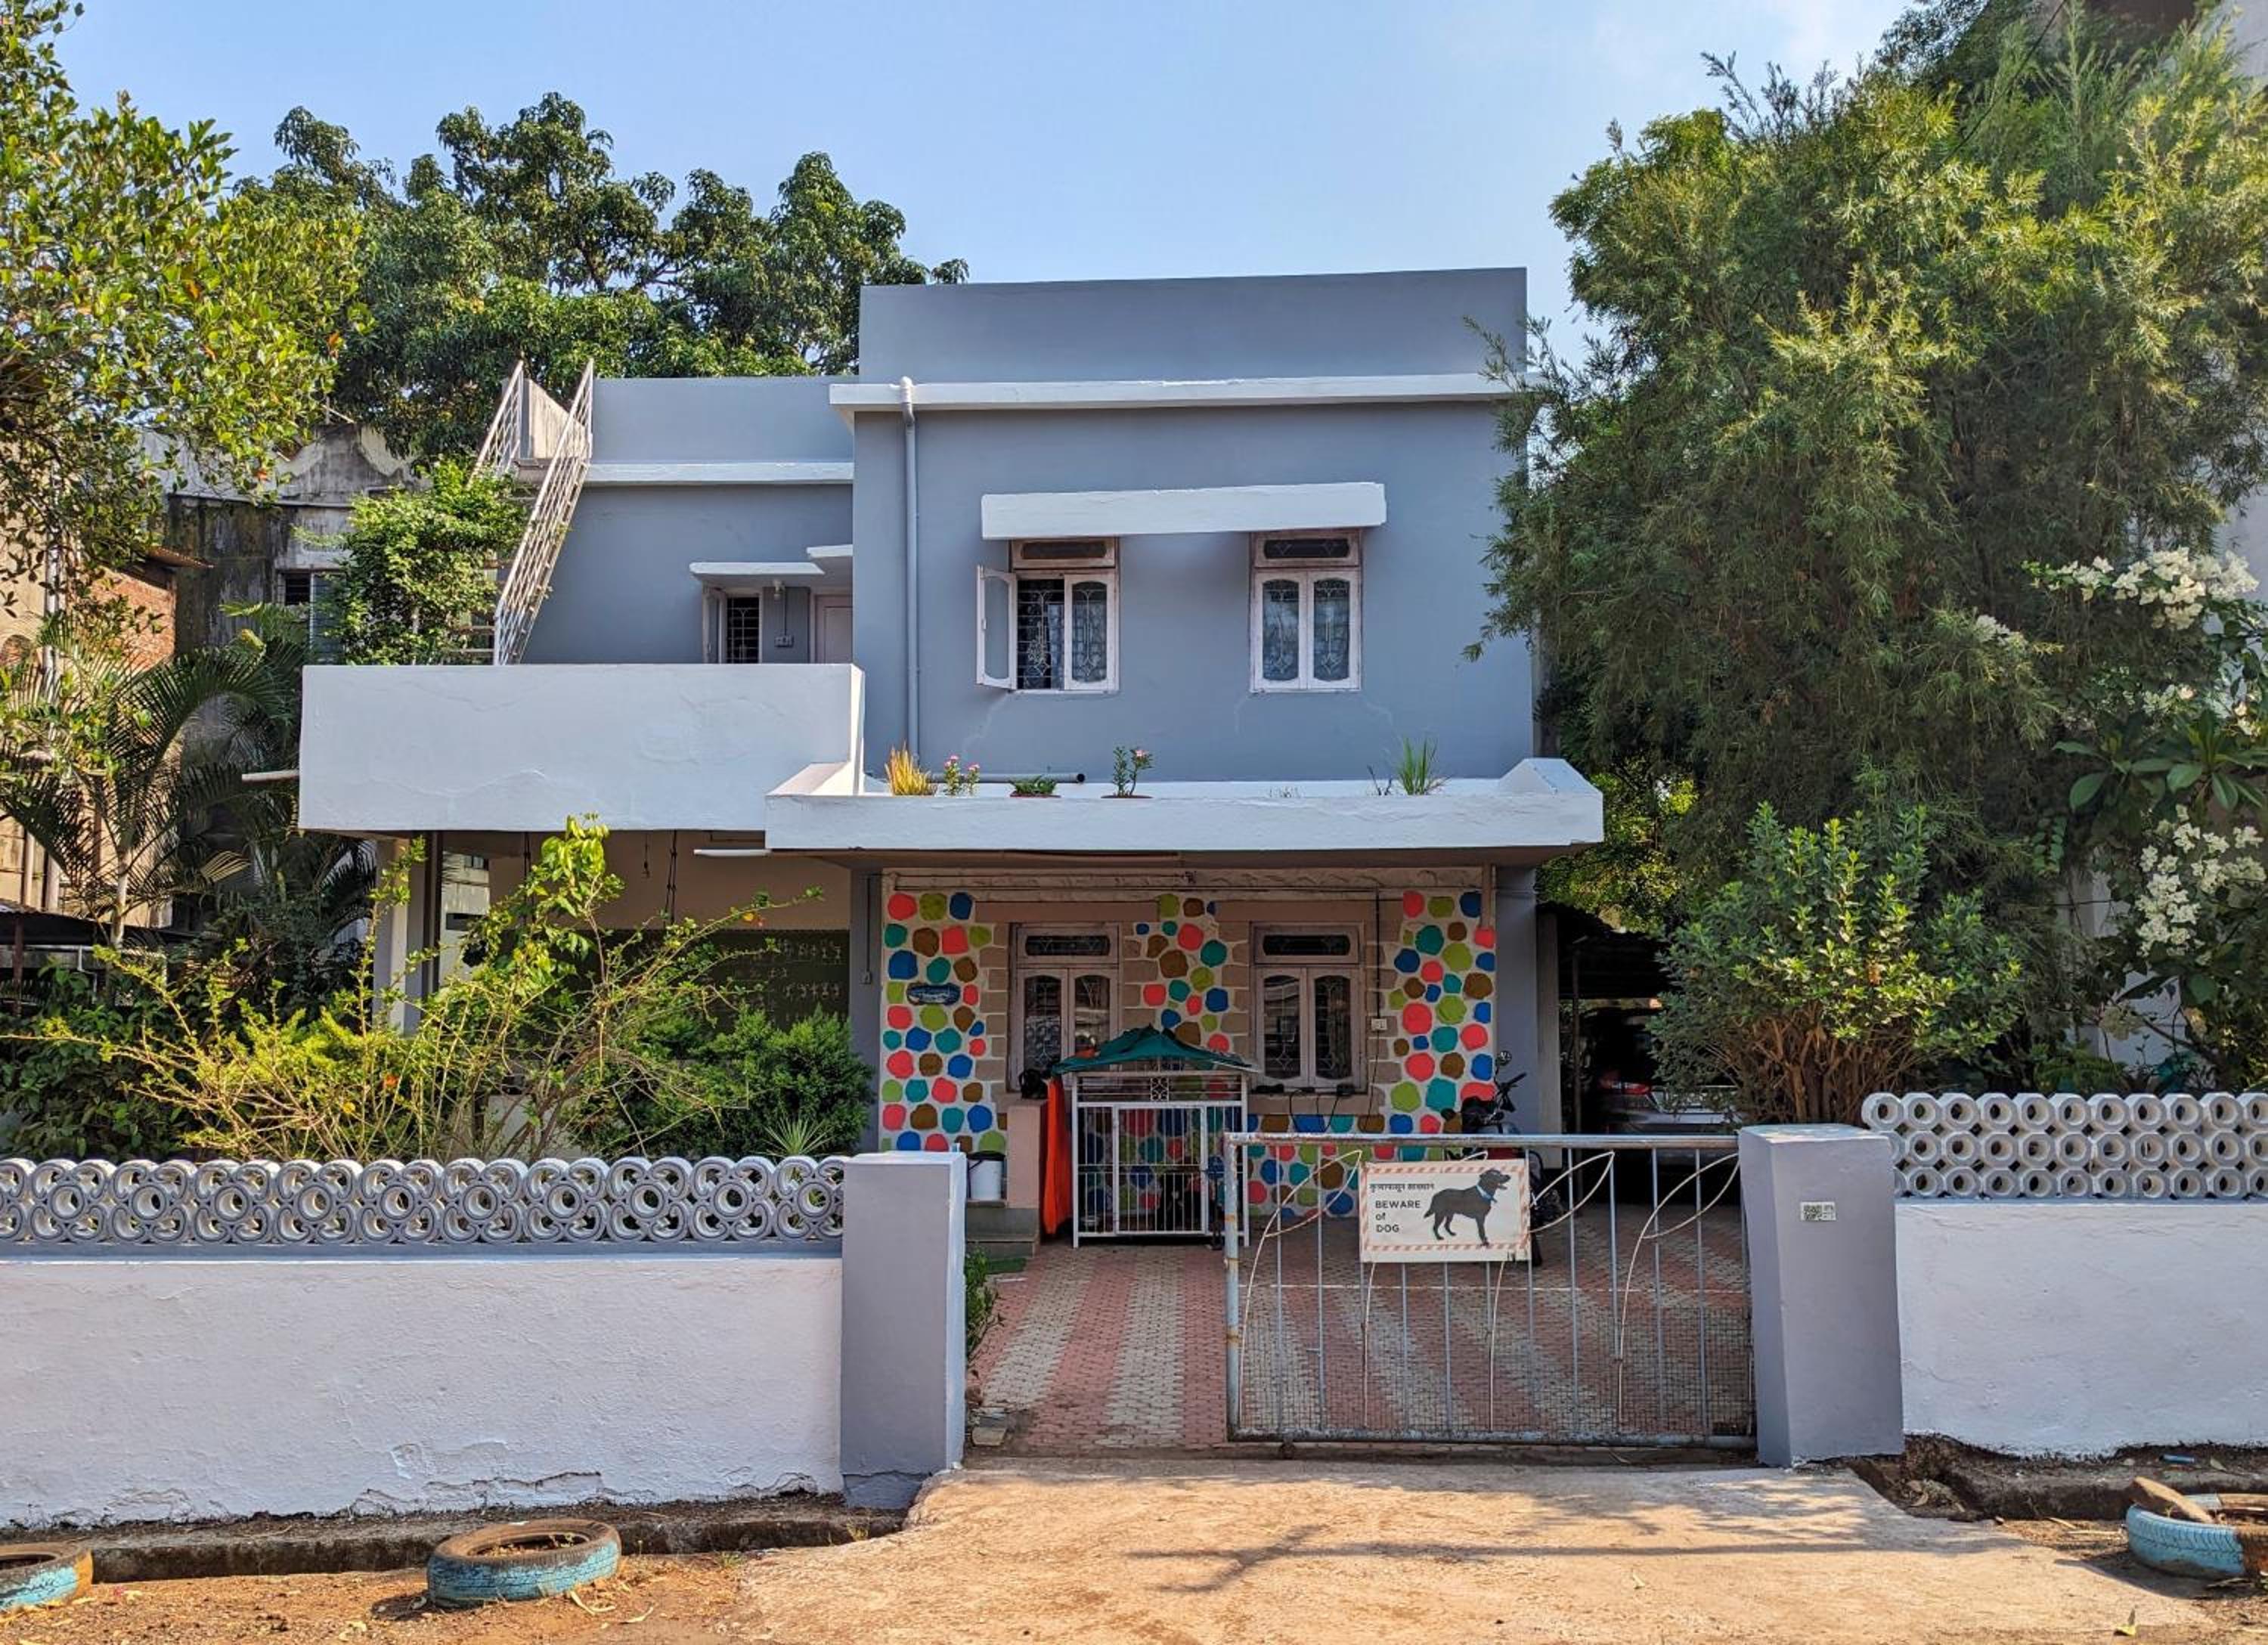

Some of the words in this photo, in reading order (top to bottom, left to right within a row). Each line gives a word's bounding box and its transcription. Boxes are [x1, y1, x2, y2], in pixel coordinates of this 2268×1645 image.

[1375, 1200, 1421, 1209] BEWARE
[1375, 1212, 1386, 1221] of
[1376, 1224, 1399, 1233] DOG
